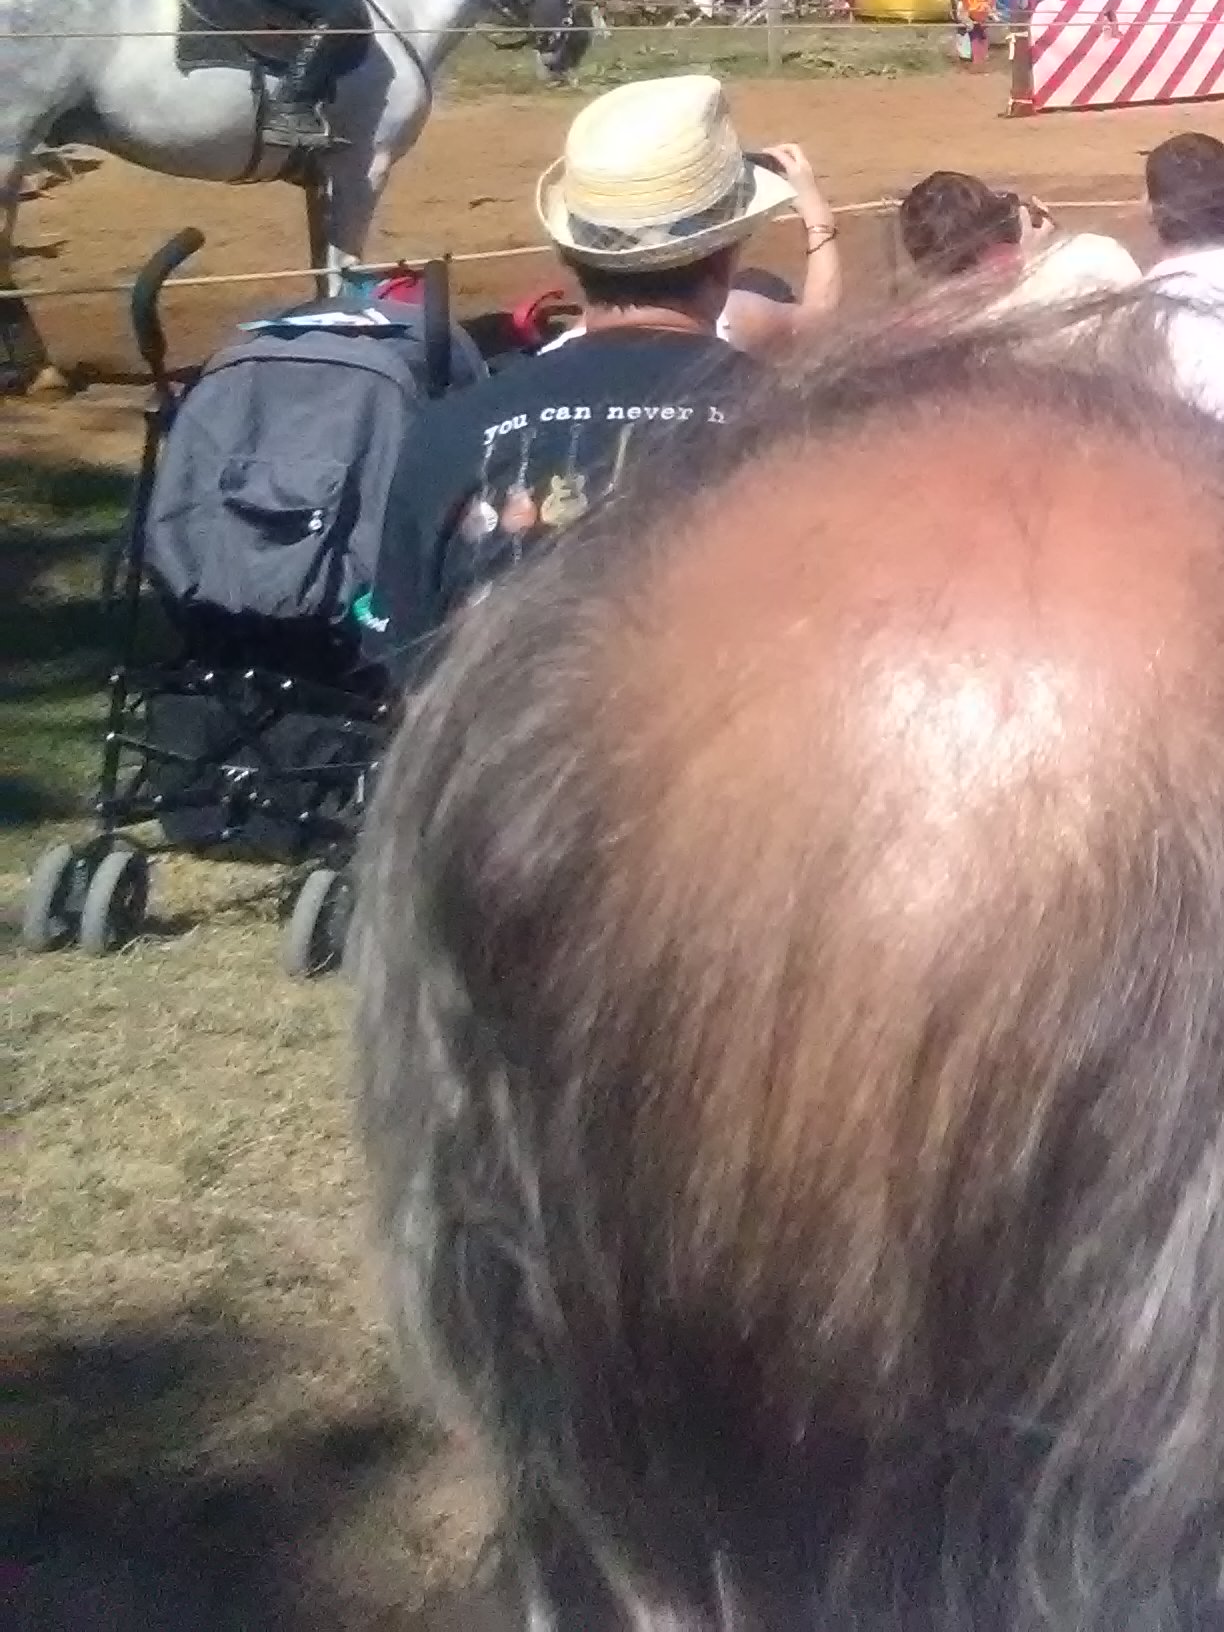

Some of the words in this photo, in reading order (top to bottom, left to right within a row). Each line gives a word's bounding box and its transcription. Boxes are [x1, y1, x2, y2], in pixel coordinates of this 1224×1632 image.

[483, 413, 528, 445] you
[540, 405, 592, 422] can
[606, 405, 694, 421] never
